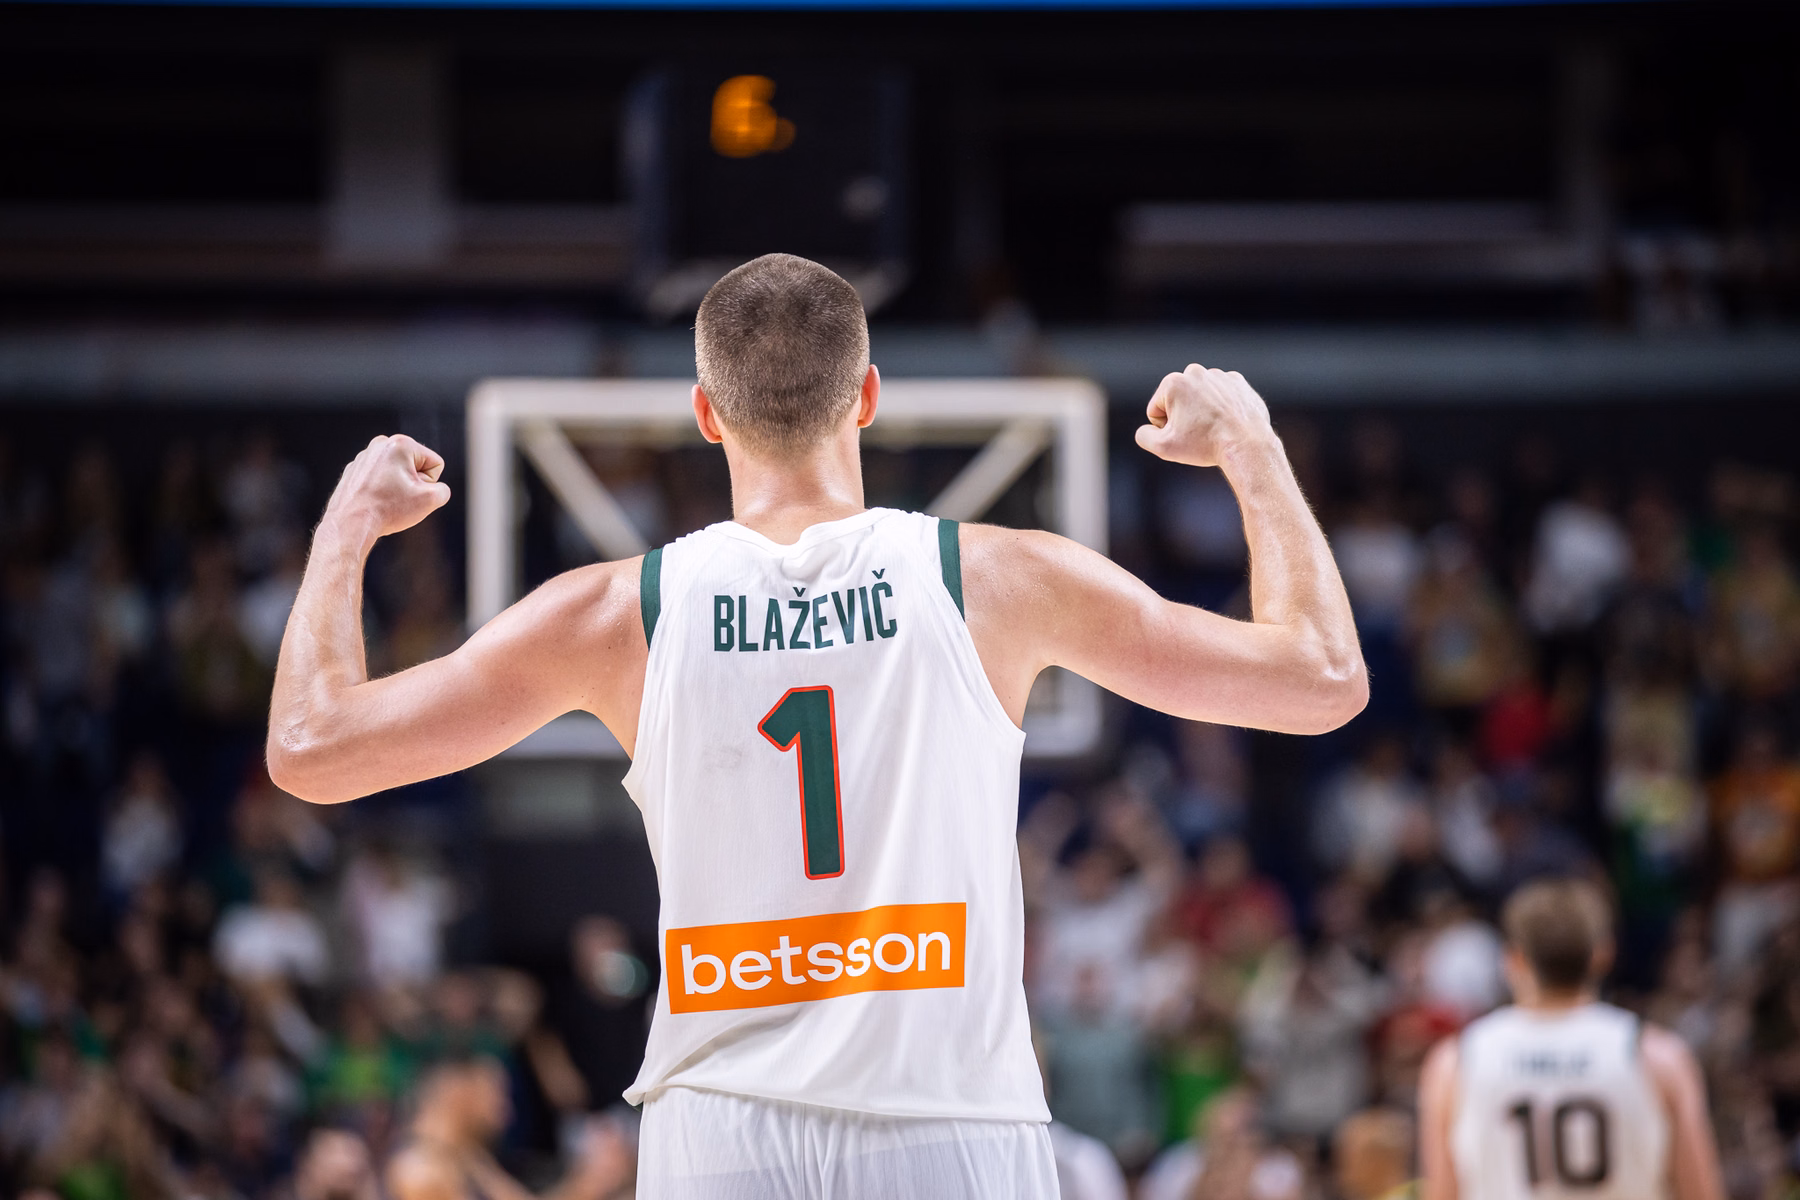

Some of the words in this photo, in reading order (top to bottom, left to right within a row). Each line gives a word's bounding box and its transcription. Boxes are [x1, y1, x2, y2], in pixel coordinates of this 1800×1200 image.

[713, 568, 898, 652] BLAŽEVIČ
[758, 685, 845, 880] 1
[681, 931, 951, 995] betsson
[1505, 1096, 1612, 1190] 10
